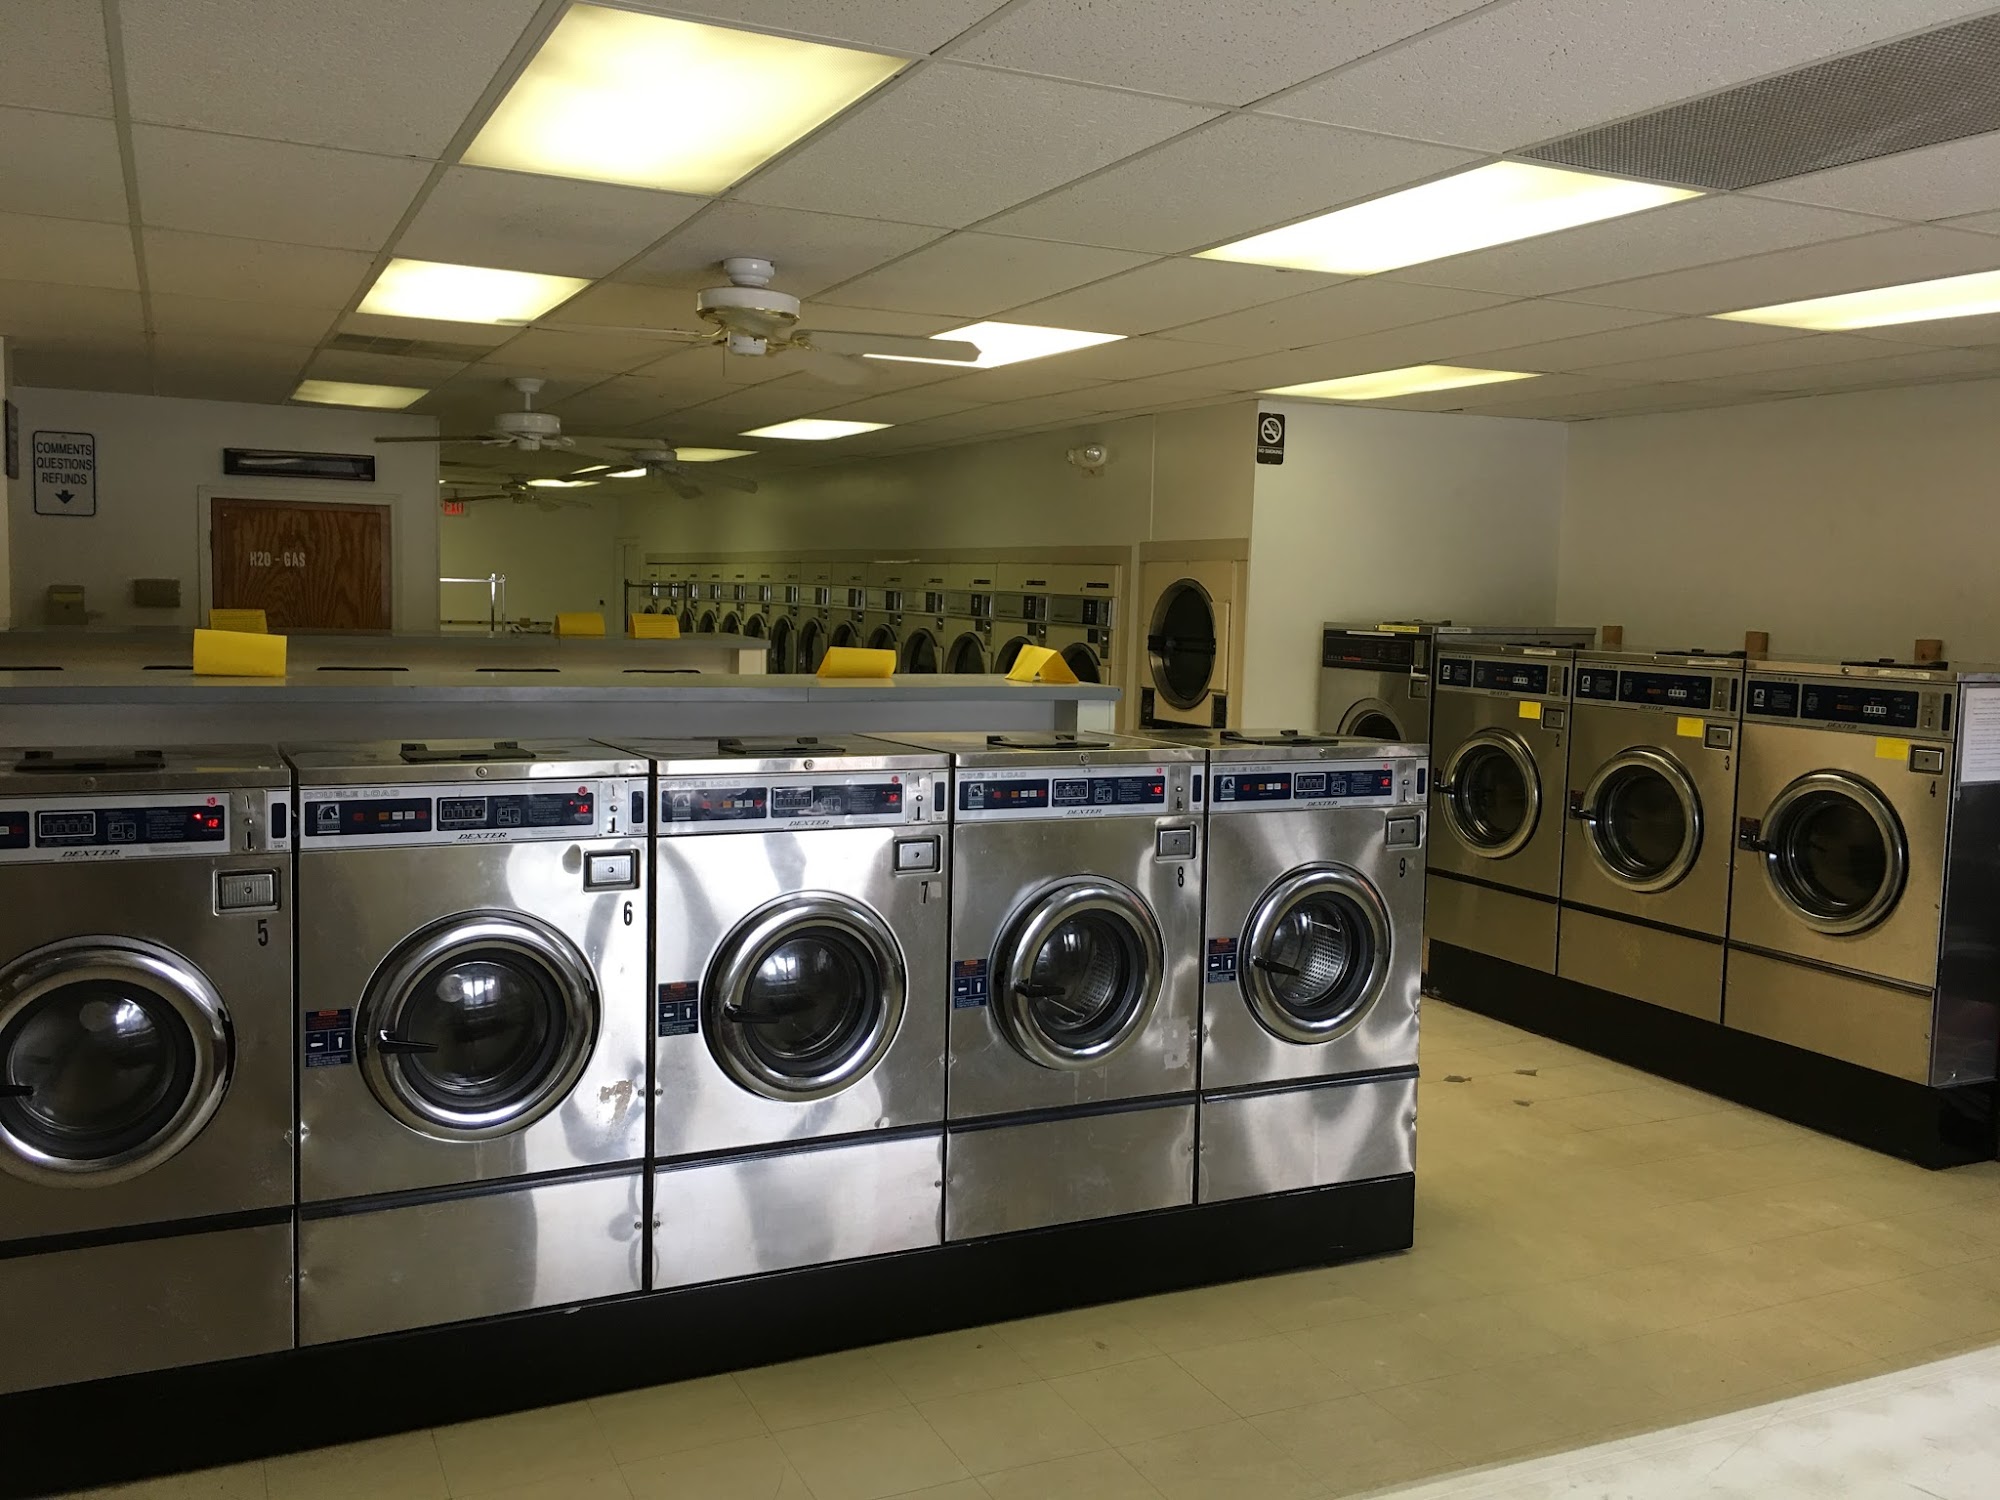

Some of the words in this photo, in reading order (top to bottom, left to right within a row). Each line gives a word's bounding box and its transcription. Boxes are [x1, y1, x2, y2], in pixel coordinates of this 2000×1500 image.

[36, 442, 92, 456] COMMENTS
[36, 457, 92, 470] QUESTIONS
[42, 472, 87, 485] REFUNDS
[284, 551, 306, 568] GAS
[1827, 722, 1857, 730] DEXTER
[1556, 733, 1561, 747] 2
[1724, 755, 1730, 771] 3
[303, 790, 360, 800] DOUBLE
[363, 789, 400, 797] LOAD
[1930, 781, 1936, 797] 4
[580, 804, 589, 813] 12
[208, 818, 219, 828] 12
[788, 819, 830, 827] DEXTER
[457, 832, 507, 840] DEXTER
[61, 849, 120, 858] DEXTER
[1398, 858, 1407, 878] 9
[1177, 866, 1185, 888] 8
[920, 881, 929, 904] 7
[623, 901, 634, 926] 6
[257, 919, 268, 947] 5
